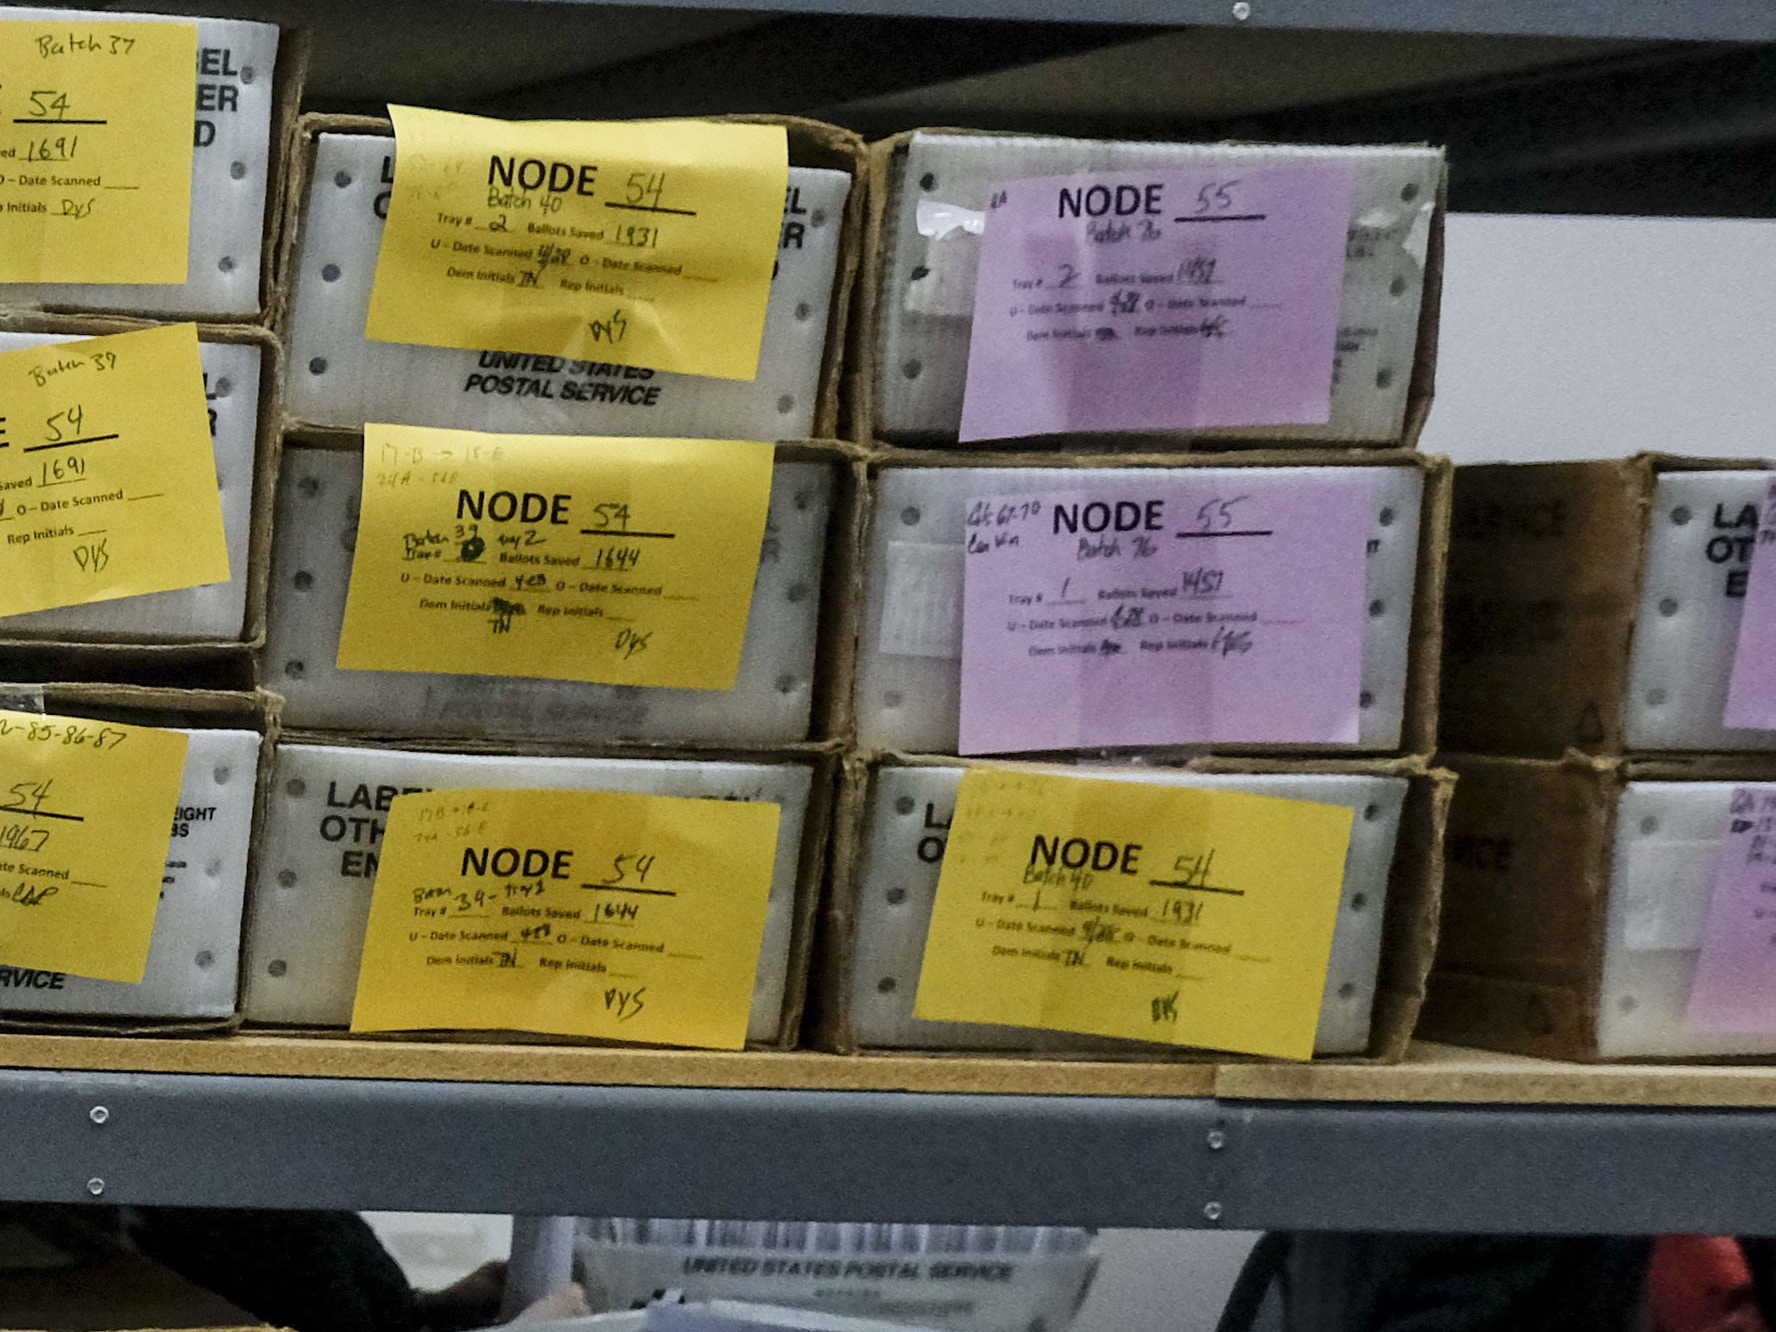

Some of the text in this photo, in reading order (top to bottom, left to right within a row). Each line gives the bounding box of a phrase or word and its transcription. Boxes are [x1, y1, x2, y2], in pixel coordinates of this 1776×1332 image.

[36, 36, 136, 55] Batch 37
[29, 91, 71, 121] 54
[27, 136, 77, 162] 1691
[489, 156, 667, 203] NODE 54
[7, 202, 46, 213] Initials
[465, 374, 661, 407] POSTAL SERVICE
[46, 408, 85, 438] 54
[37, 459, 90, 486] 1691
[457, 490, 629, 529] NODE 54
[1054, 499, 1248, 533] NODE 55
[8, 782, 55, 811] 54
[1031, 835, 1142, 874] NODE
